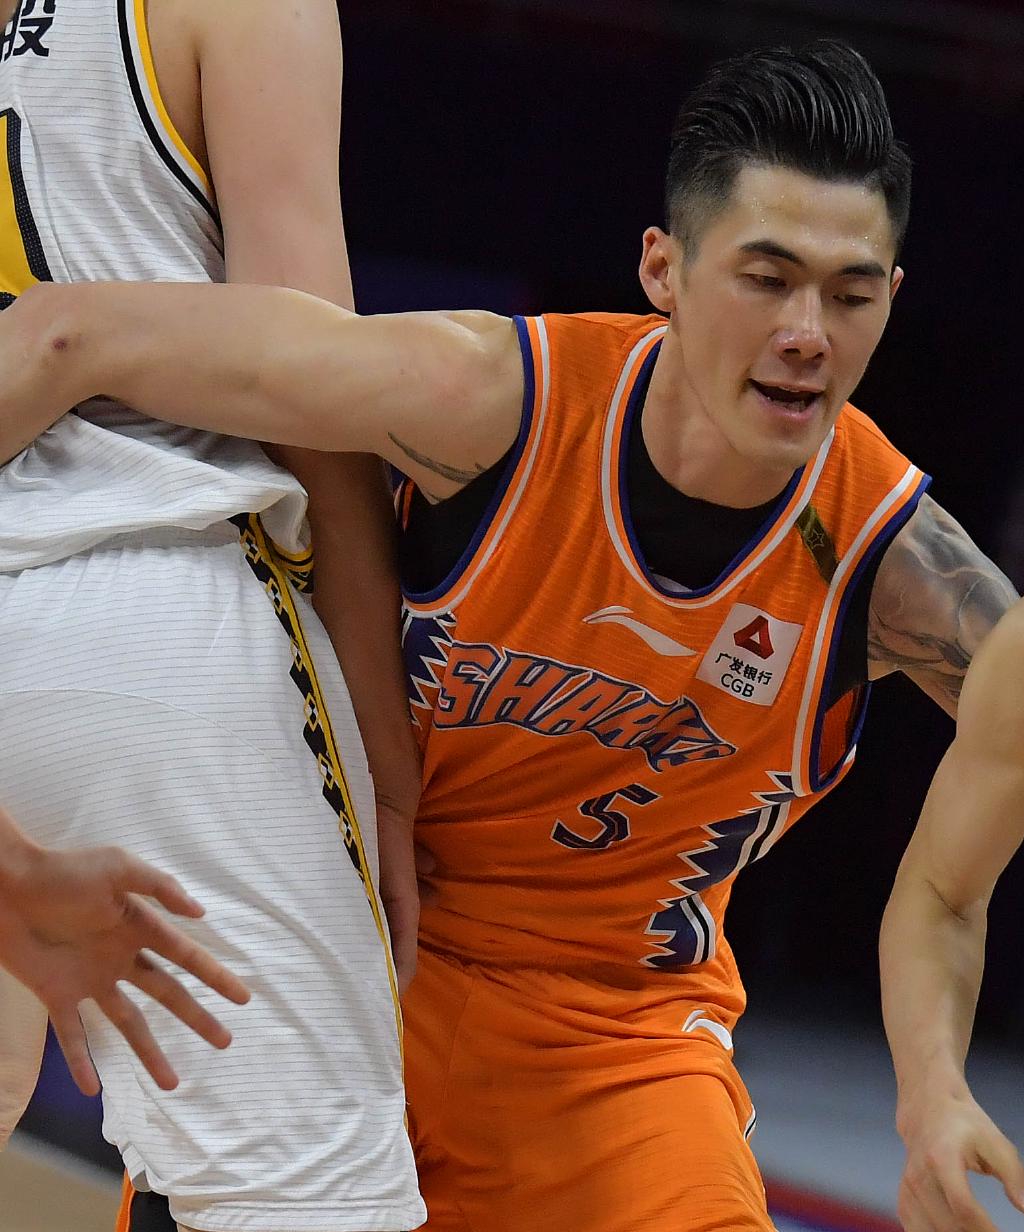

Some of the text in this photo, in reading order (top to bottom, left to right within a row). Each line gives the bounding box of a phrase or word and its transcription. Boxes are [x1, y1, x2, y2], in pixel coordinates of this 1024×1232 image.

[715, 652, 773, 686] 广发银行
[721, 673, 755, 698] CGB
[550, 783, 662, 851] 5
